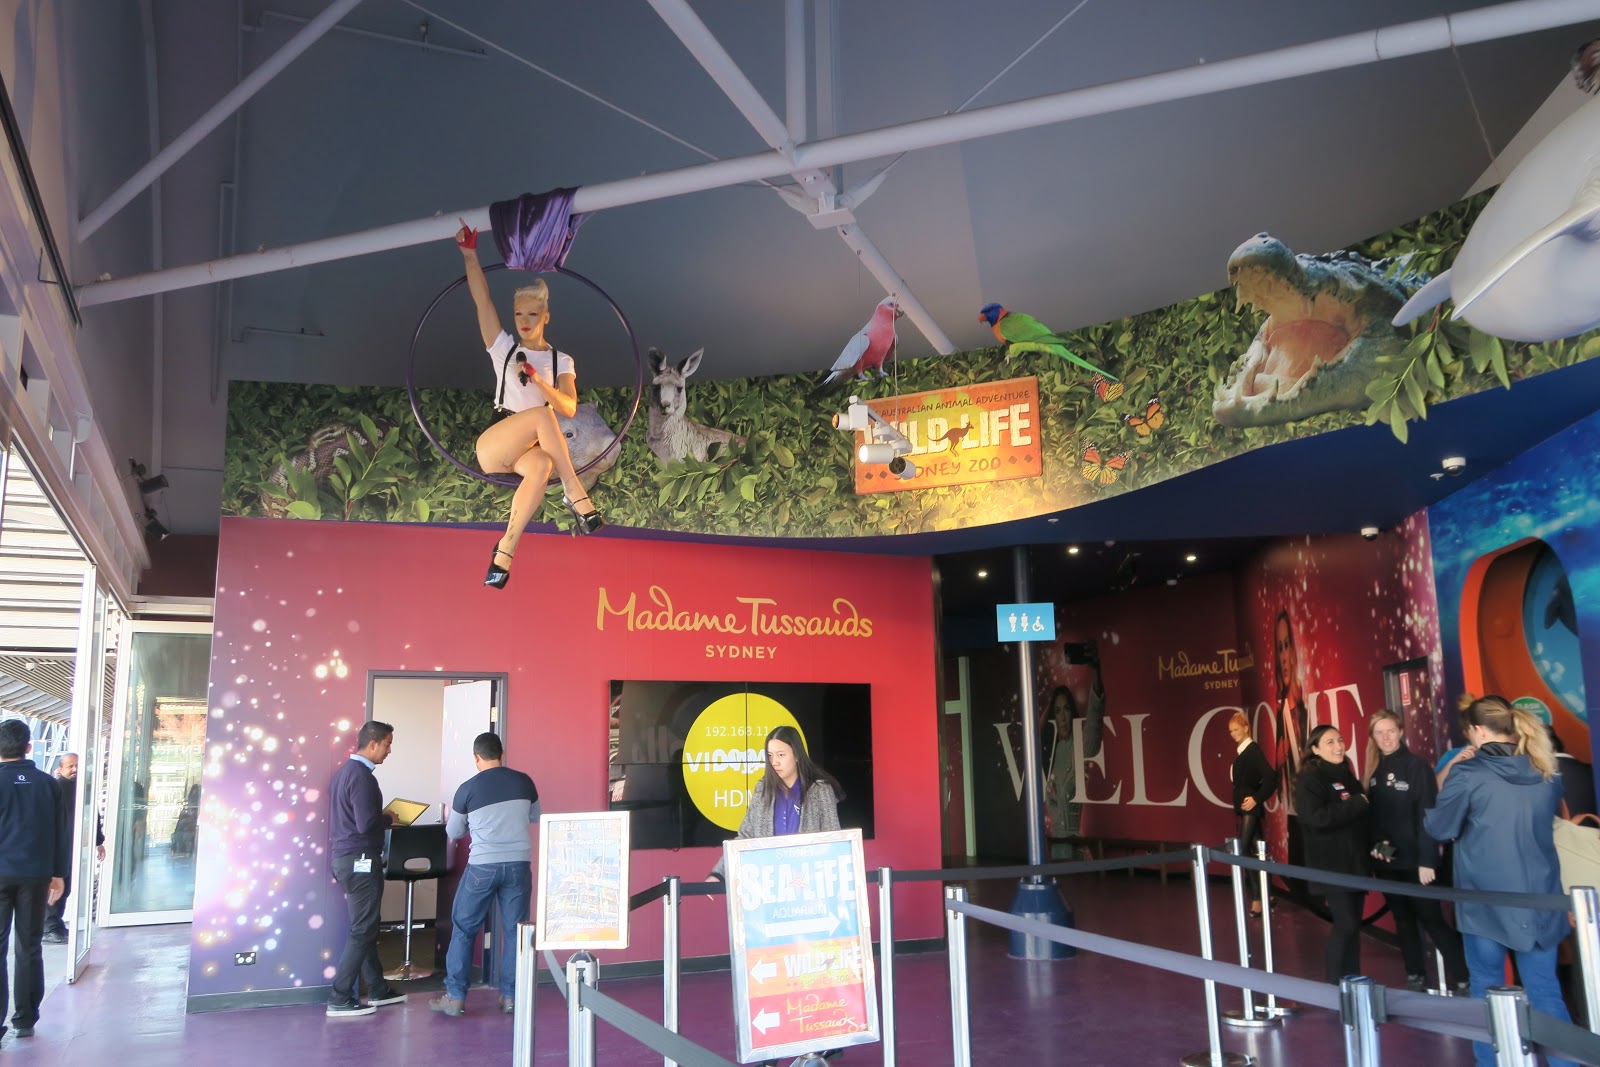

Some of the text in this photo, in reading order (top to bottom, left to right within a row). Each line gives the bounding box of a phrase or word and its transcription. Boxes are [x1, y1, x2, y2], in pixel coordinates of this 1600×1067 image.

[881, 390, 1031, 417] AUSTRALIAN ANIMAL ADVENTURE
[960, 403, 1032, 449] LIFE
[893, 457, 1001, 481] DNEY ZOO
[596, 585, 873, 638] Madame Tussauds
[705, 645, 777, 659] SYDNEY
[1158, 650, 1222, 680] Madame
[1204, 679, 1239, 690] SYDNEY
[772, 902, 827, 919] AQUARIUM
[783, 950, 827, 978] WILD
[786, 993, 848, 1015] Madame
[789, 1008, 860, 1034] Tussauds
